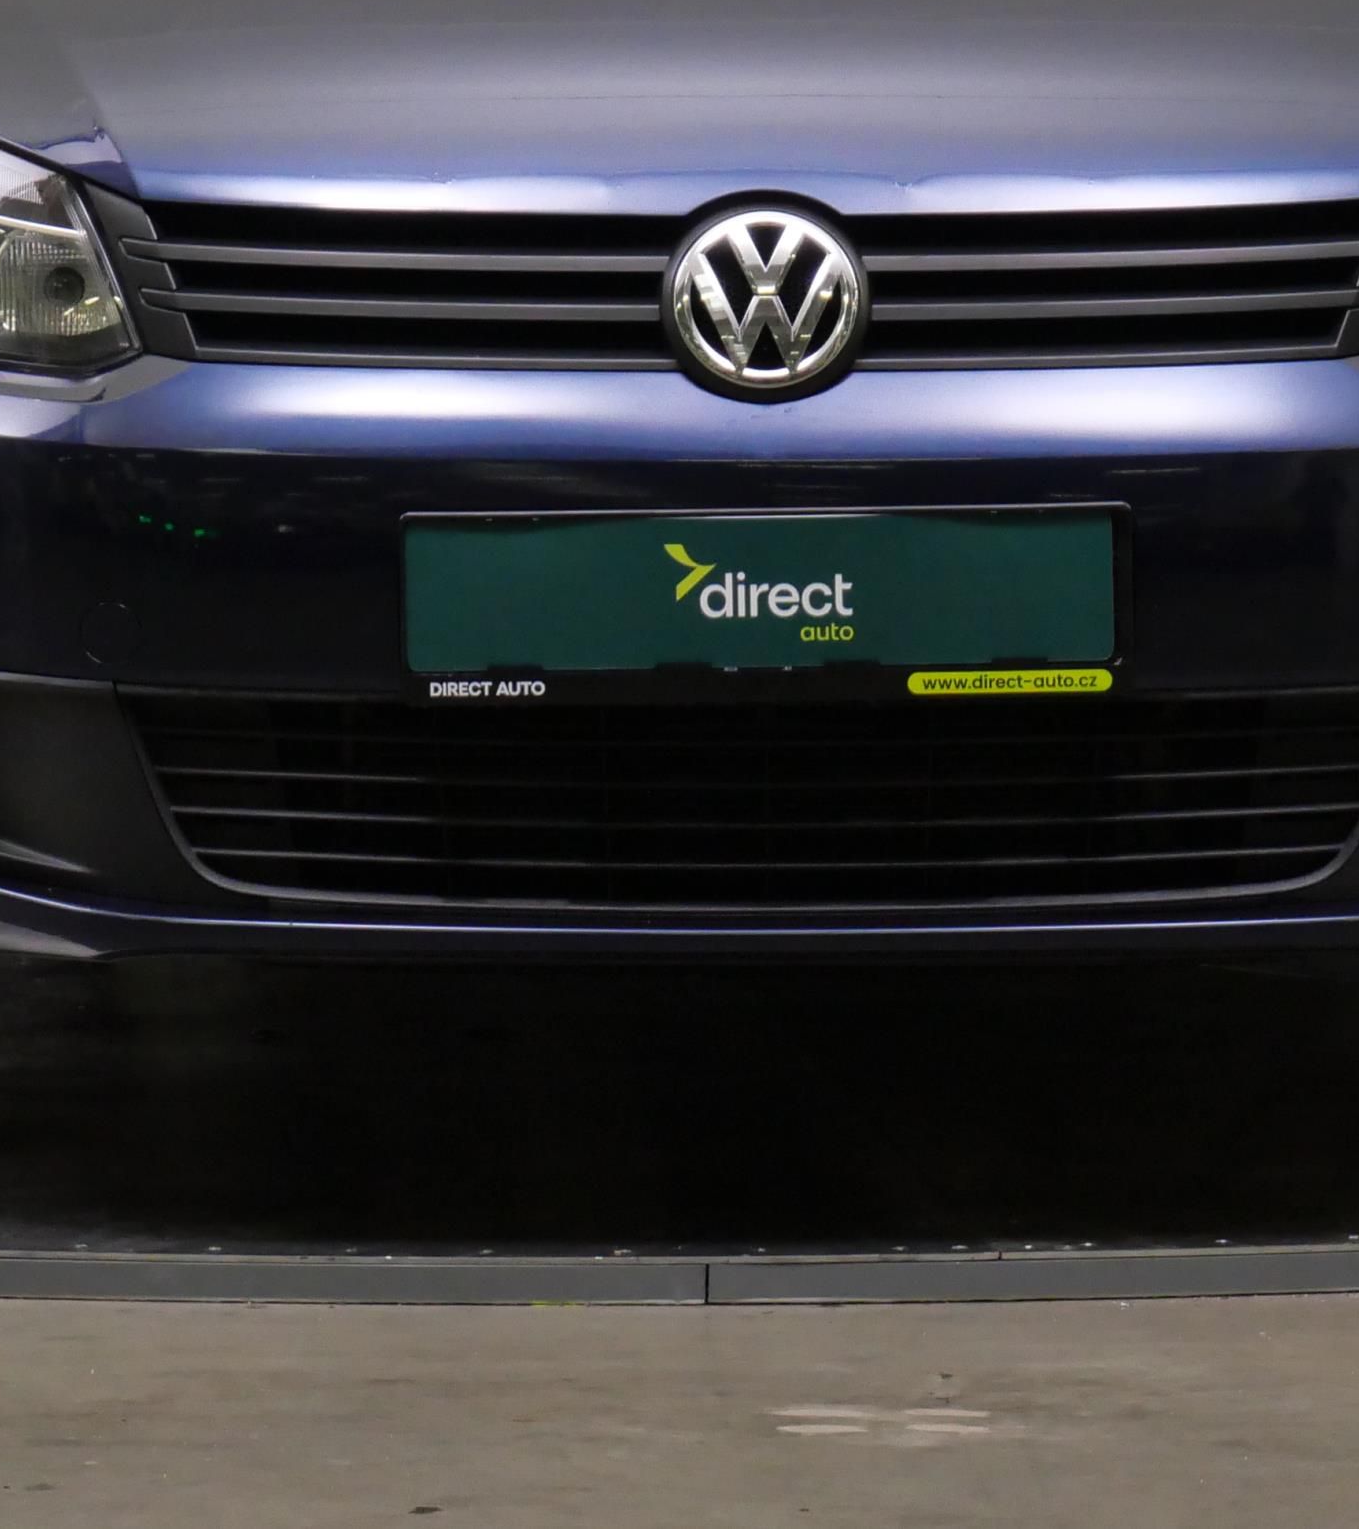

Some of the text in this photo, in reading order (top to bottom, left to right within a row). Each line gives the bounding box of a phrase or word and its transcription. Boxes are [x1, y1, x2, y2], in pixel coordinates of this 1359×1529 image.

[699, 571, 854, 619] direct
[800, 623, 854, 641] auto
[429, 680, 546, 697] DIRECT AUTO
[922, 673, 1098, 690] www.direct-auto.cz
